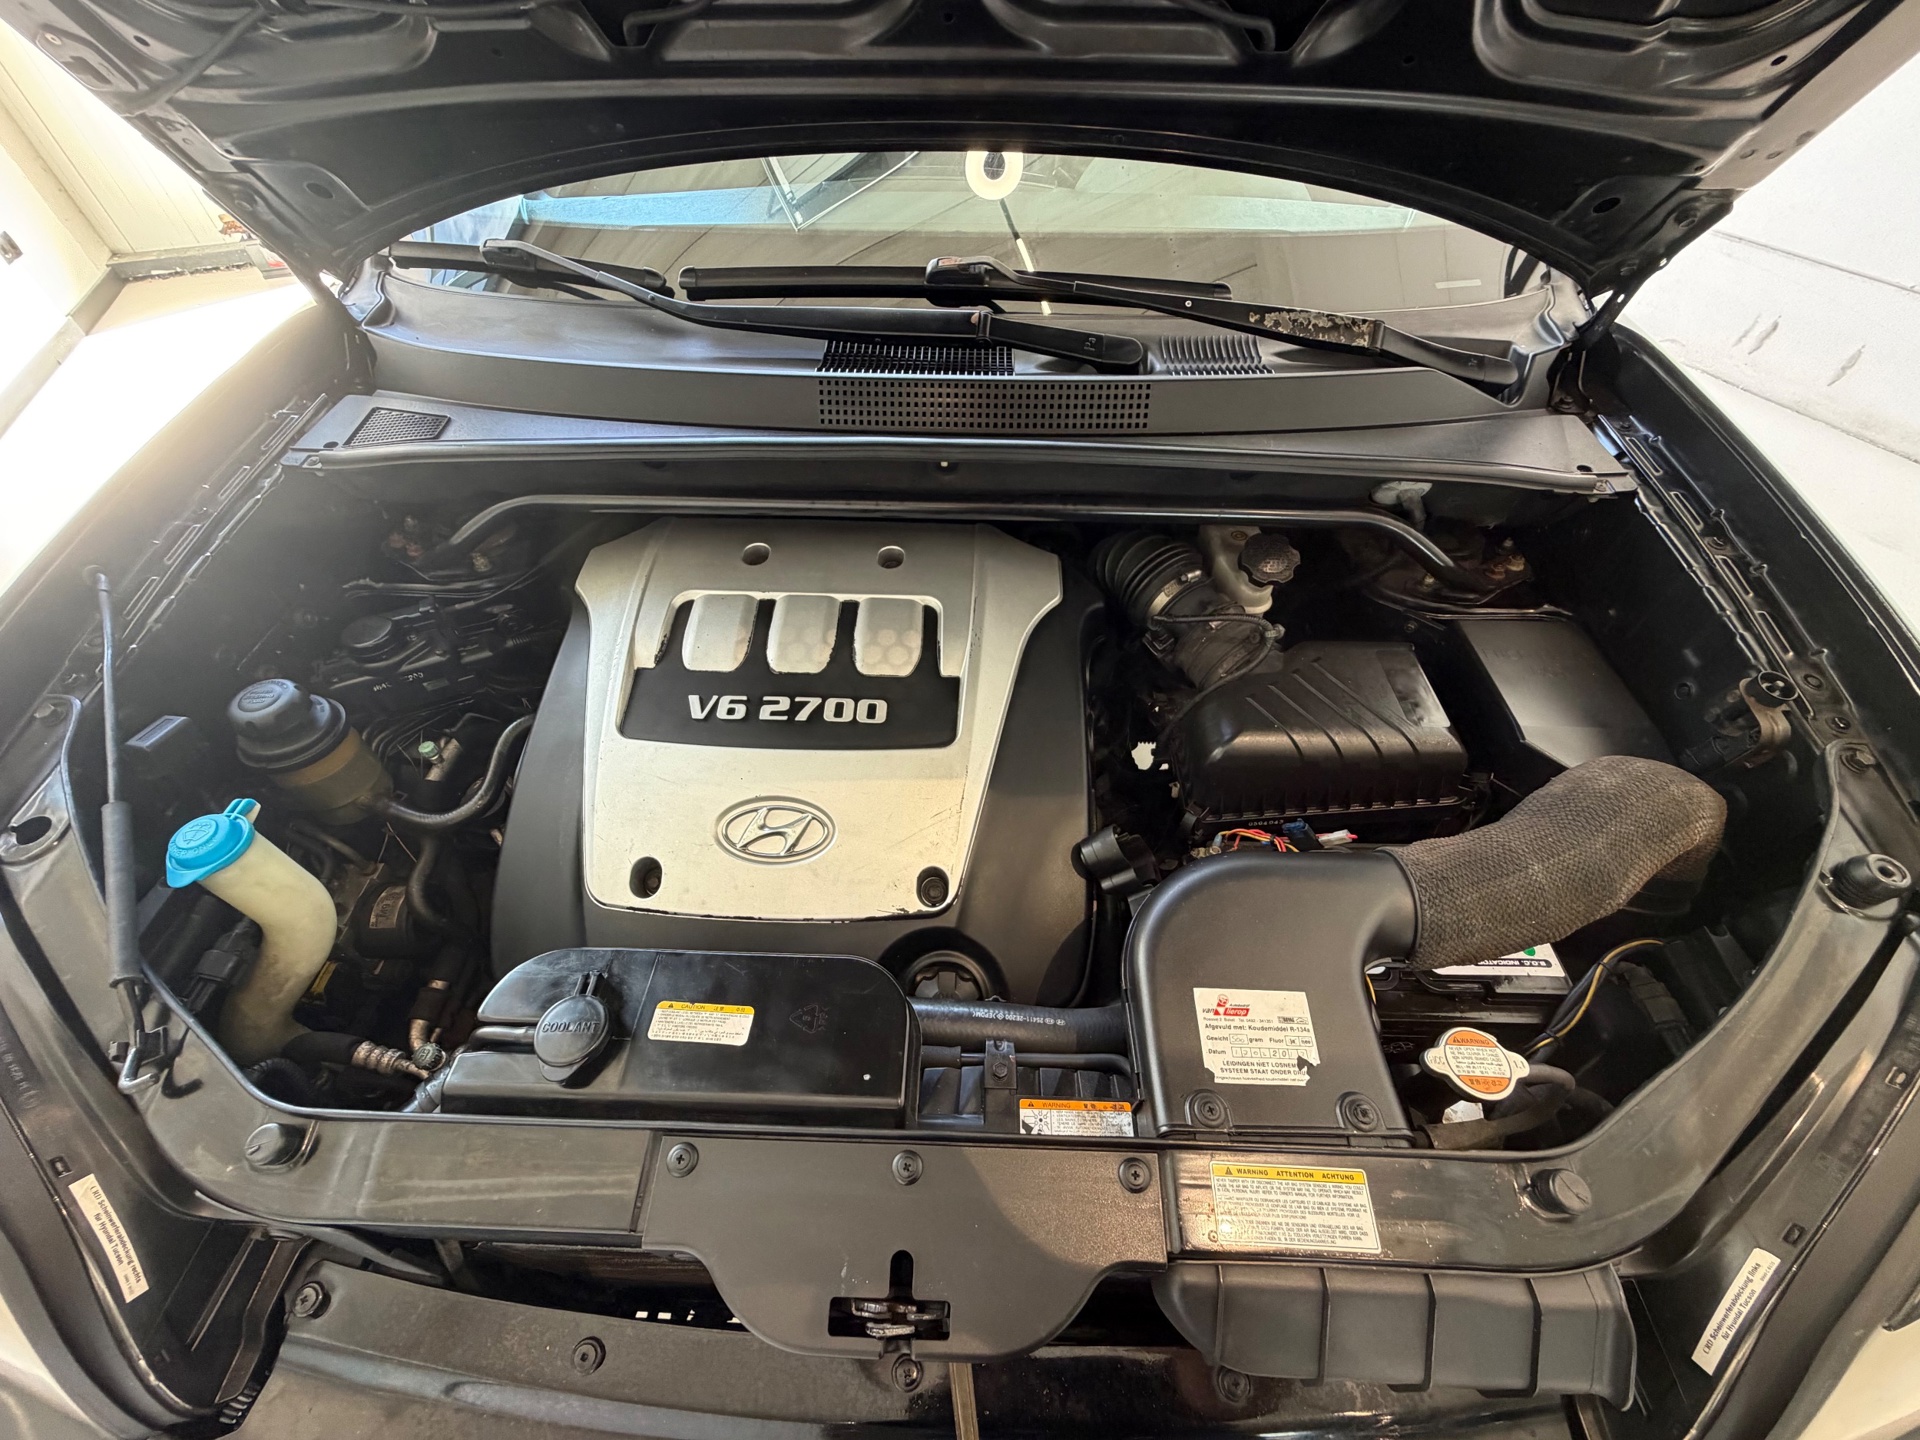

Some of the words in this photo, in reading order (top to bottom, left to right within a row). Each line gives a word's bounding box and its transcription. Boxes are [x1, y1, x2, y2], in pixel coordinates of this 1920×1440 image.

[688, 694, 748, 720] V6
[759, 696, 888, 724] 2700
[541, 1021, 600, 1034] COOLANT
[1205, 1024, 1232, 1032] Afgevuld
[1461, 1037, 1490, 1045] WARNING
[1236, 1168, 1268, 1176] WARNING
[1276, 1170, 1314, 1179] ATTENTION
[1322, 1173, 1354, 1181] ACHTUNG
[99, 1200, 134, 1266] Scheinwerferabdeckung
[130, 1260, 142, 1284] rechts
[100, 1219, 116, 1246] Hyundai
[110, 1242, 124, 1266] Tucson
[1710, 1277, 1755, 1341] Scheinwerferabdeckung
[1750, 1262, 1762, 1279] links
[1721, 1330, 1732, 1341] für
[1728, 1307, 1744, 1333] Hyundai
[1739, 1288, 1756, 1310] Tucson
